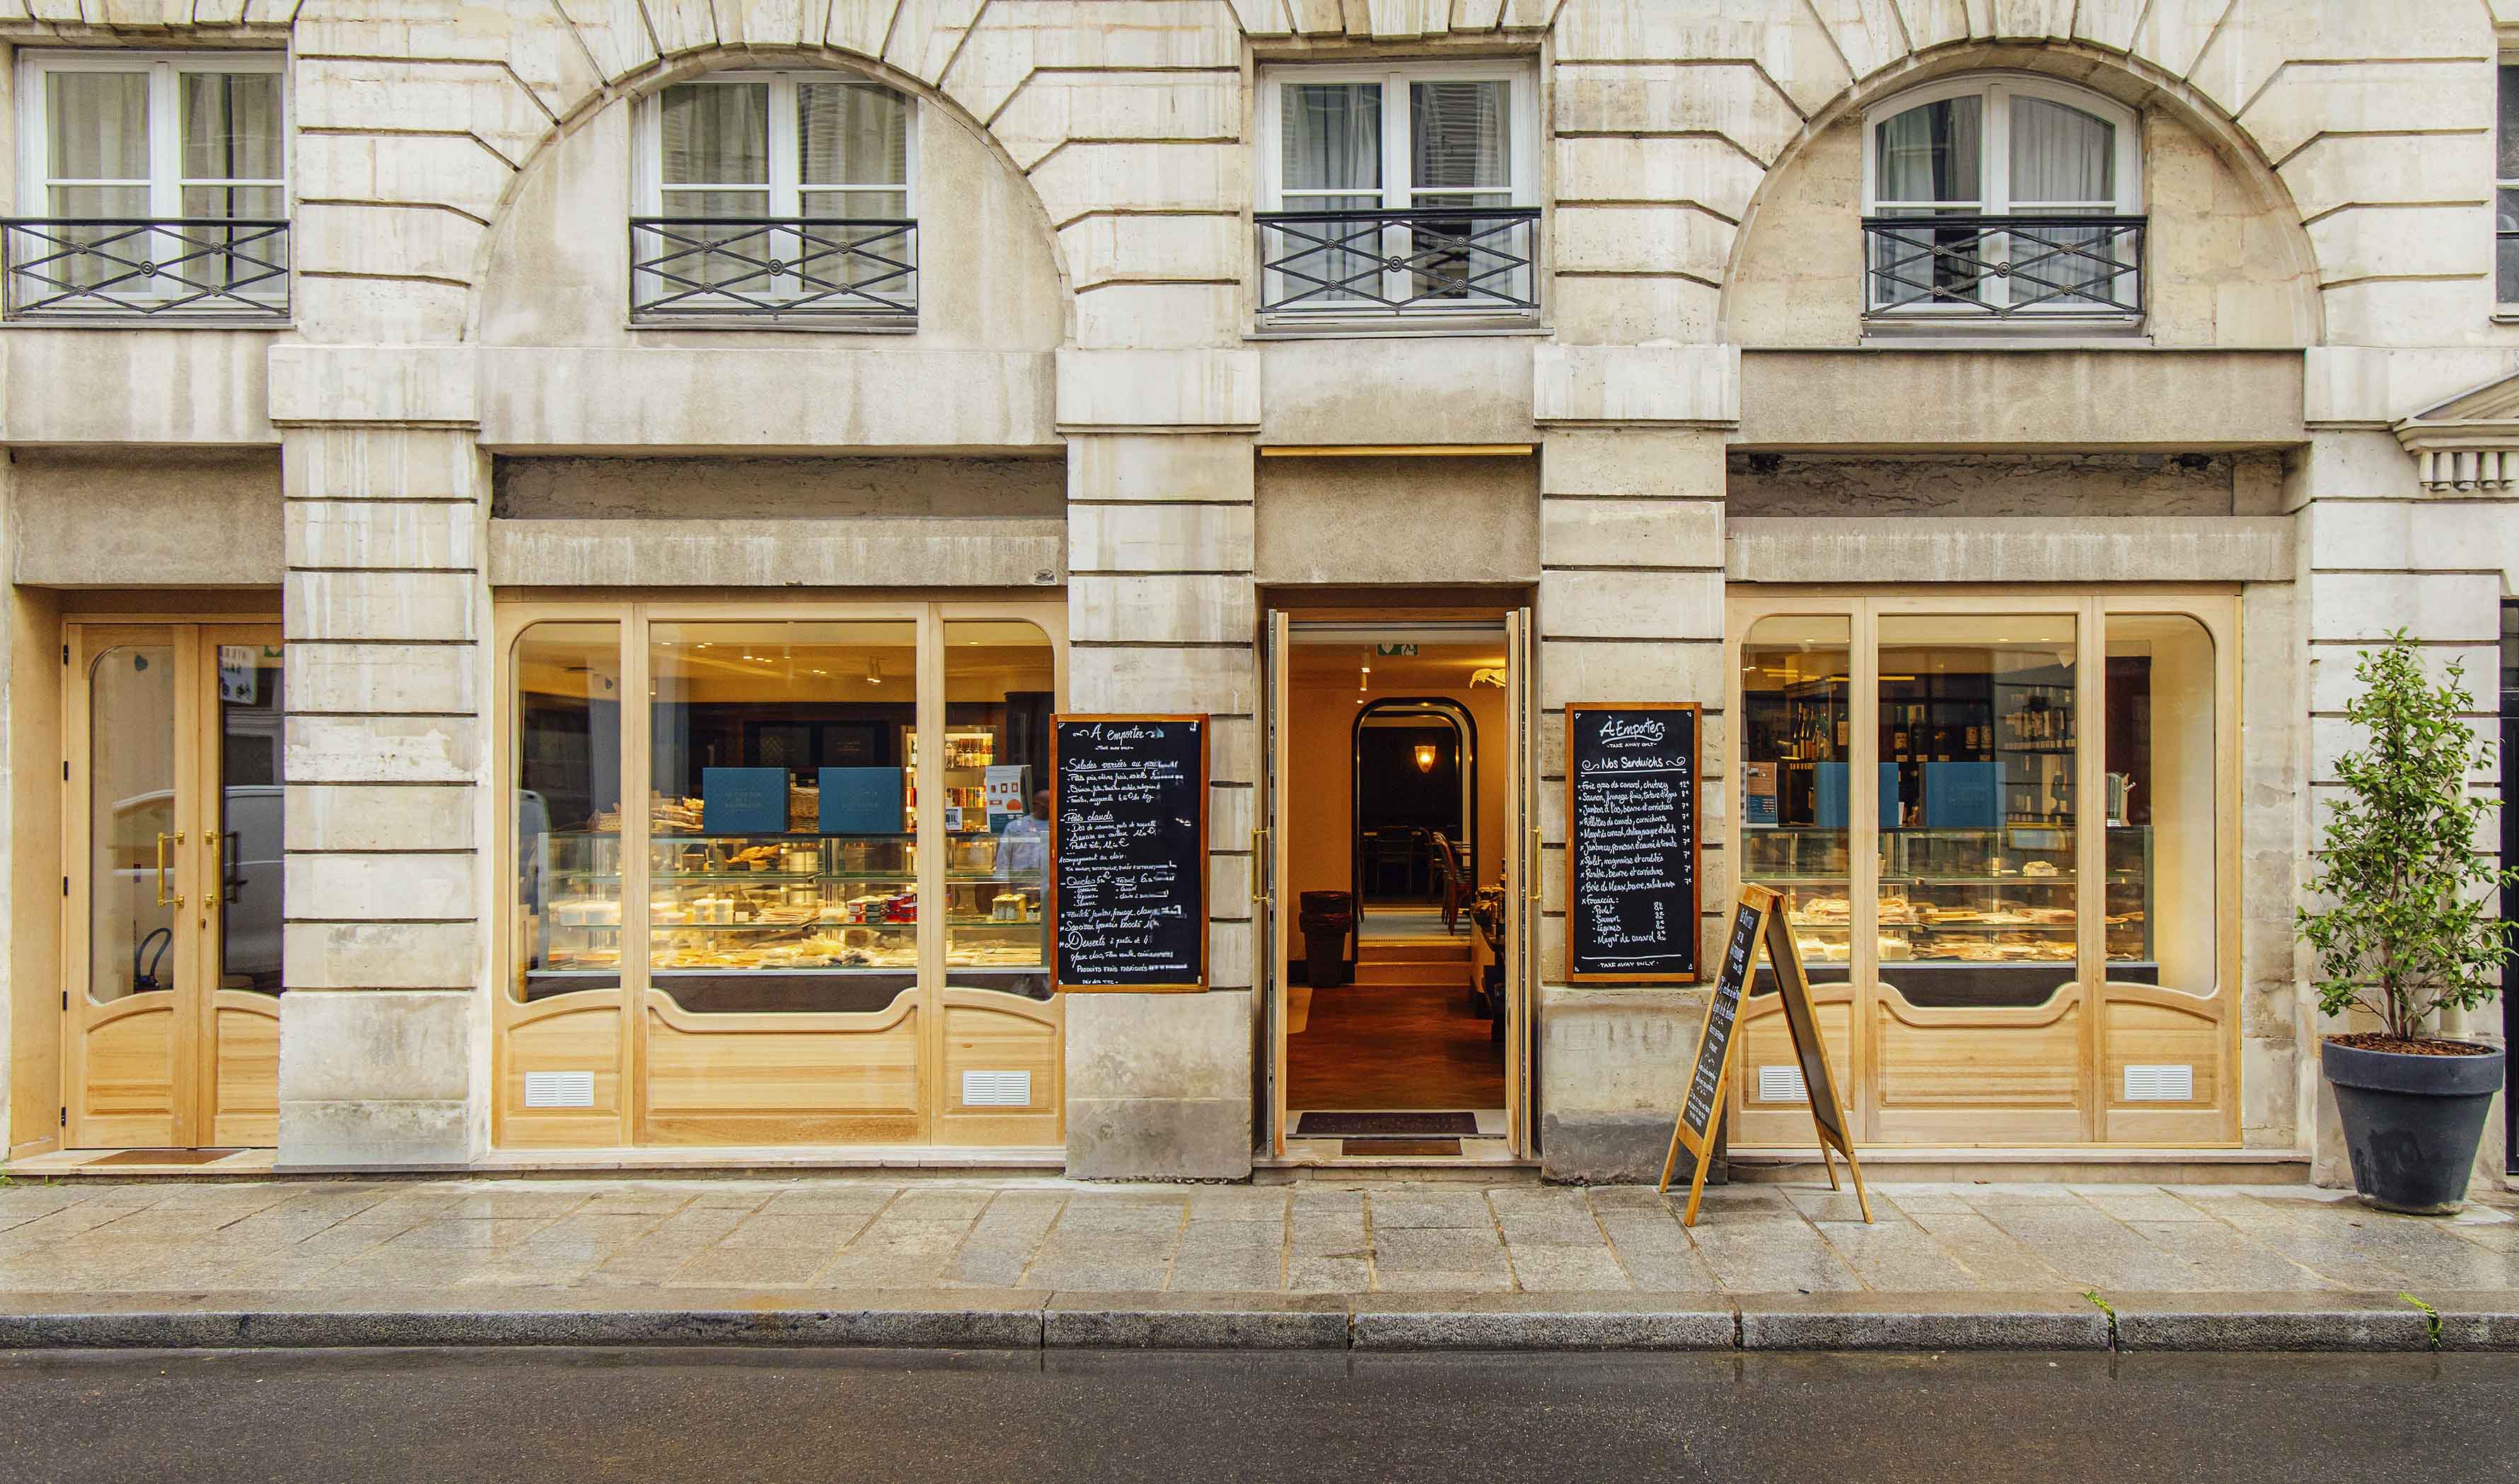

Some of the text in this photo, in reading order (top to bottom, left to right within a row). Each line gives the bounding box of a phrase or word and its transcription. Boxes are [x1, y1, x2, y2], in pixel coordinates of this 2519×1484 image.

[1599, 714, 1615, 737] À
[1090, 722, 1145, 746] À emporter
[1065, 758, 1097, 771] Salades
[1602, 758, 1618, 770] Nos
[1582, 781, 1596, 789] Foie
[1597, 782, 1610, 793] gras
[1611, 780, 1618, 789] de
[1643, 779, 1669, 791] chutney
[1087, 810, 1113, 821] chauds
[1585, 881, 1600, 893] Brie
[1600, 881, 1608, 891] de
[1593, 904, 1615, 917] Poulet
[1595, 915, 1621, 924] Saumon
[1597, 923, 1621, 936] Légumes
[1065, 931, 1106, 950] Desserts
[1597, 933, 1619, 948] Magret
[1620, 932, 1630, 943] de
[1631, 930, 1655, 943] canard
